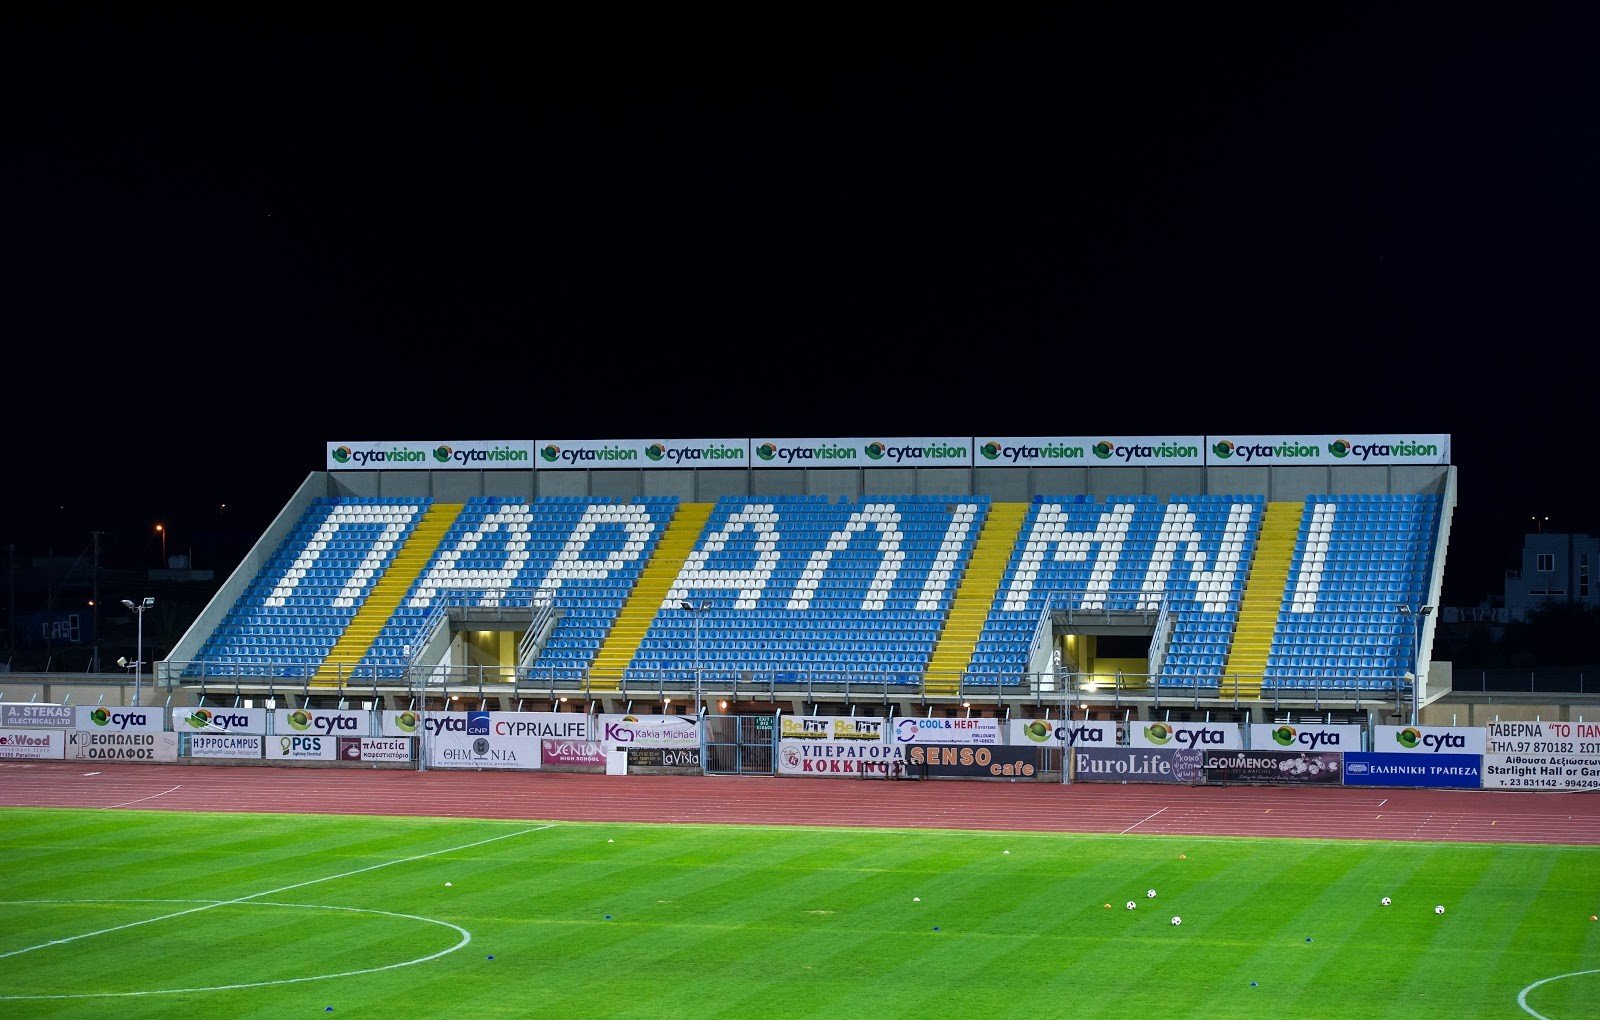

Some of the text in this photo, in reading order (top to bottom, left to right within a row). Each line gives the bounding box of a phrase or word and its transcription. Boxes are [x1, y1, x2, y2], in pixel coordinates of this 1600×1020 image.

[352, 447, 425, 466] cytavision
[454, 446, 528, 465] cytavision
[562, 446, 637, 464] cytavision
[666, 444, 744, 464] cytavision
[778, 444, 856, 463] cytavision
[887, 443, 966, 462] cytavision
[1002, 443, 1084, 462] cytavision
[1116, 442, 1198, 462] cytavision
[1236, 442, 1320, 462] cytavision
[1352, 440, 1437, 460] cytavision
[8, 707, 71, 717] A. STEKAS
[112, 712, 146, 729] cyta
[214, 713, 248, 731] cyta
[314, 714, 357, 734] cyta
[424, 715, 466, 736] cyta
[496, 722, 585, 736] CYPRIALIFE
[954, 720, 979, 729] HEAT
[1489, 724, 1542, 737] ΤΑΒΕΡΝΑ
[292, 737, 321, 751] PGS
[635, 730, 697, 739] Kakia Michael
[1054, 725, 1102, 746] cyta
[1175, 727, 1224, 748] cyta
[1298, 730, 1339, 750] cyta
[1423, 732, 1465, 752] cyta
[362, 740, 405, 750] πλατεία
[802, 745, 902, 758] ΥΠΕΡΑΓΟΡΑ
[1534, 743, 1573, 753] 870182
[910, 747, 992, 766] SENSO
[1076, 754, 1170, 774] EuroLife
[1209, 758, 1278, 769] GOUMENOS
[990, 761, 1034, 776] cafe
[1370, 765, 1478, 776] ΕΛΛΗΝΙΚΗ ΤΡΑΠΕΖΑ
[1488, 766, 1536, 776] Starlight
[1541, 767, 1562, 775] Hall
